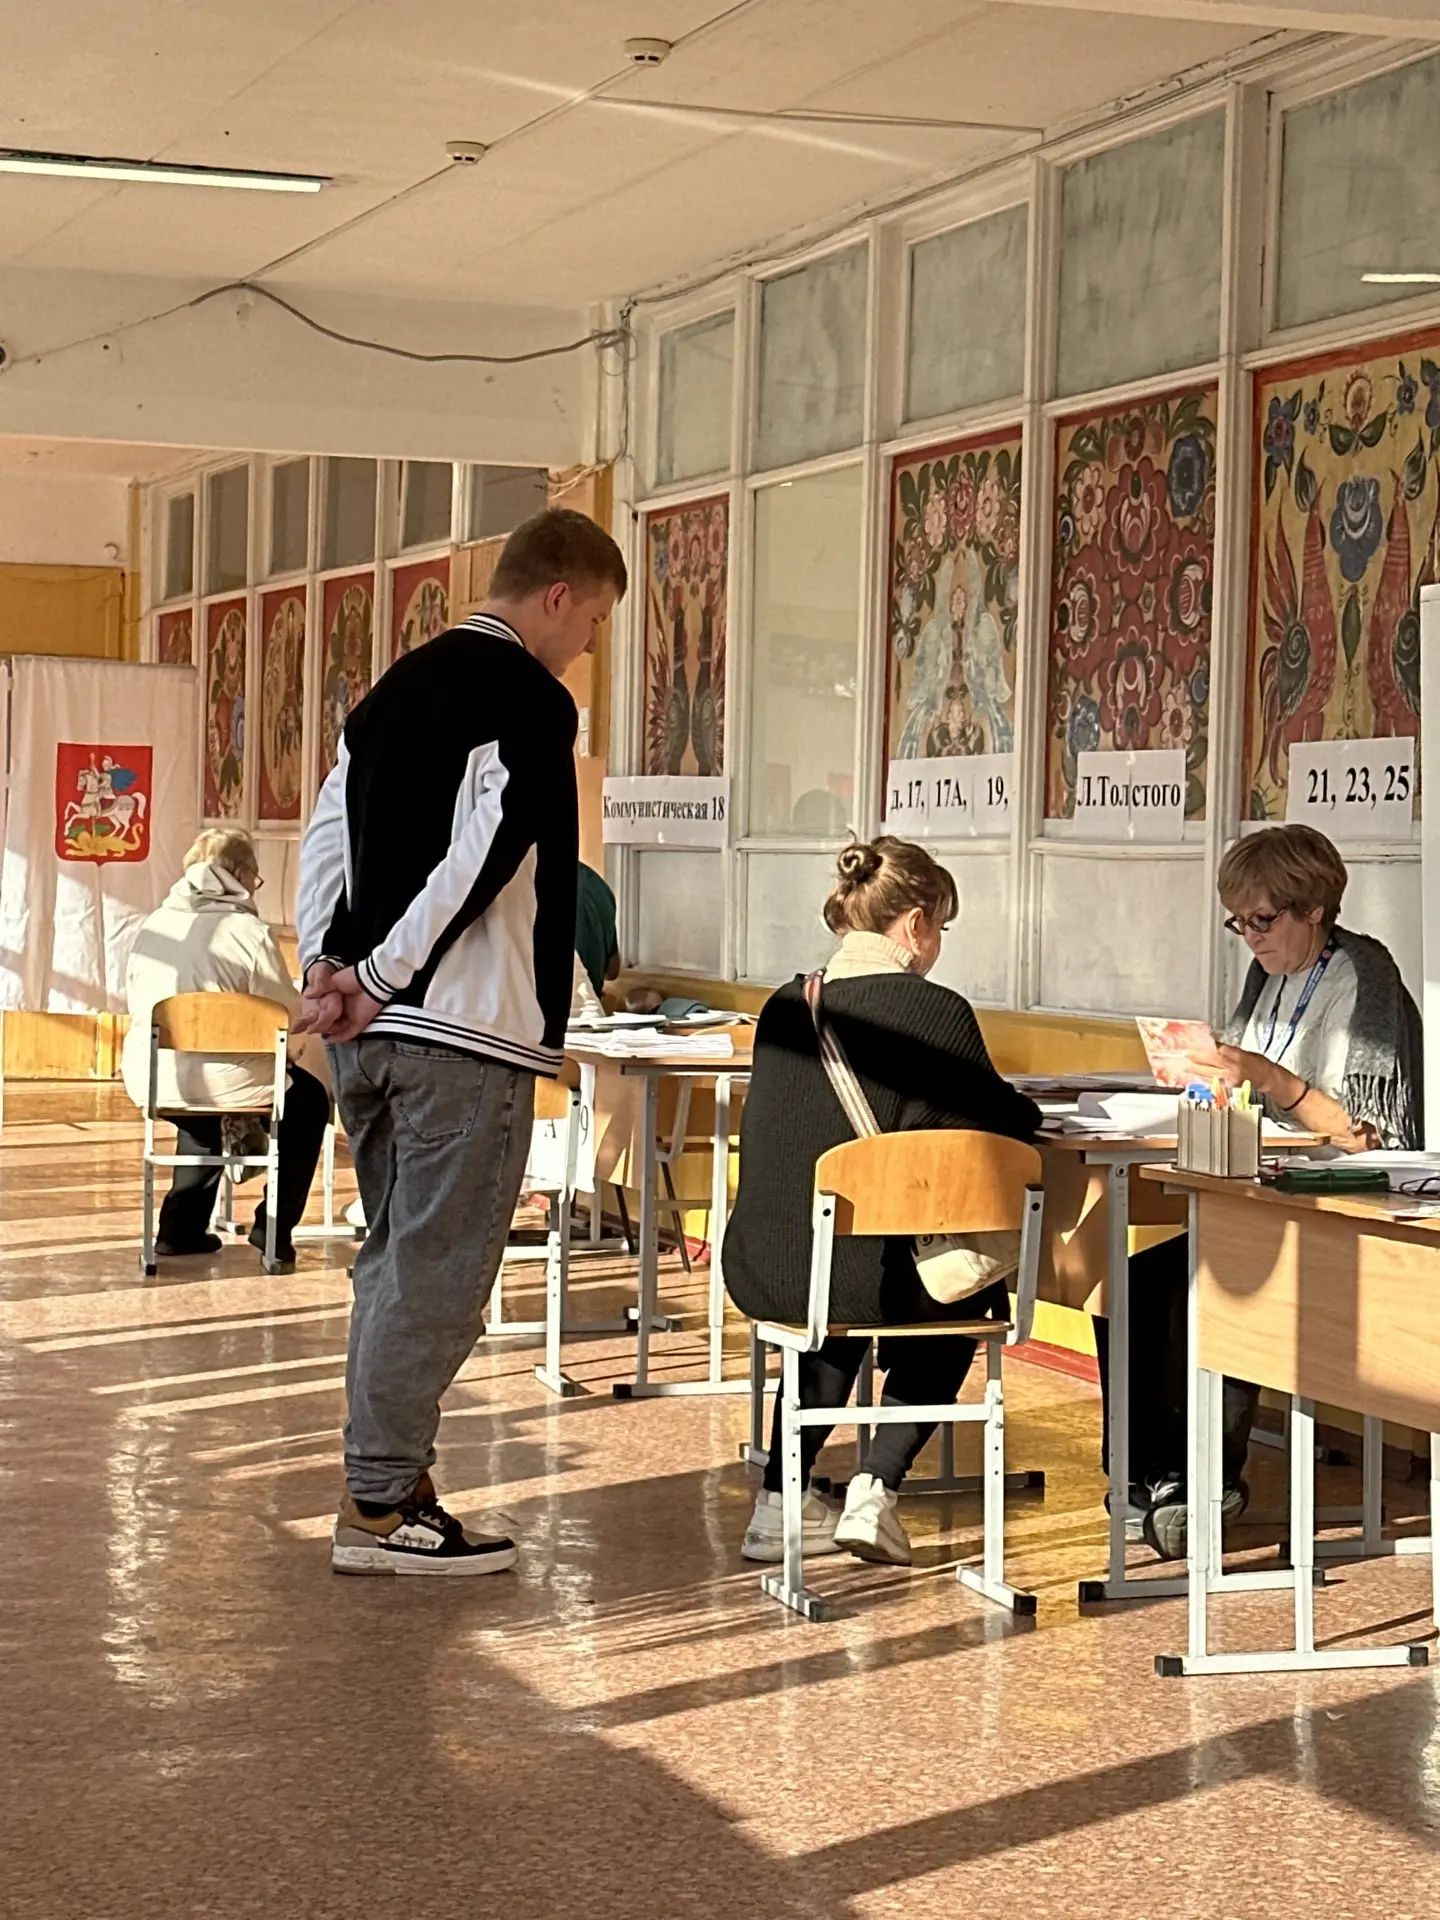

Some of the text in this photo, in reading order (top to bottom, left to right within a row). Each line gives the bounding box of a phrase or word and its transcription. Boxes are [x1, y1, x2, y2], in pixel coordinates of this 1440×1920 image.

[891, 775, 1008, 814] д. 17, 17А, 19,
[1077, 775, 1180, 807] Л.Толстого
[1307, 764, 1410, 811] 21, 23, 25
[603, 796, 725, 825] Коммунистическая 18
